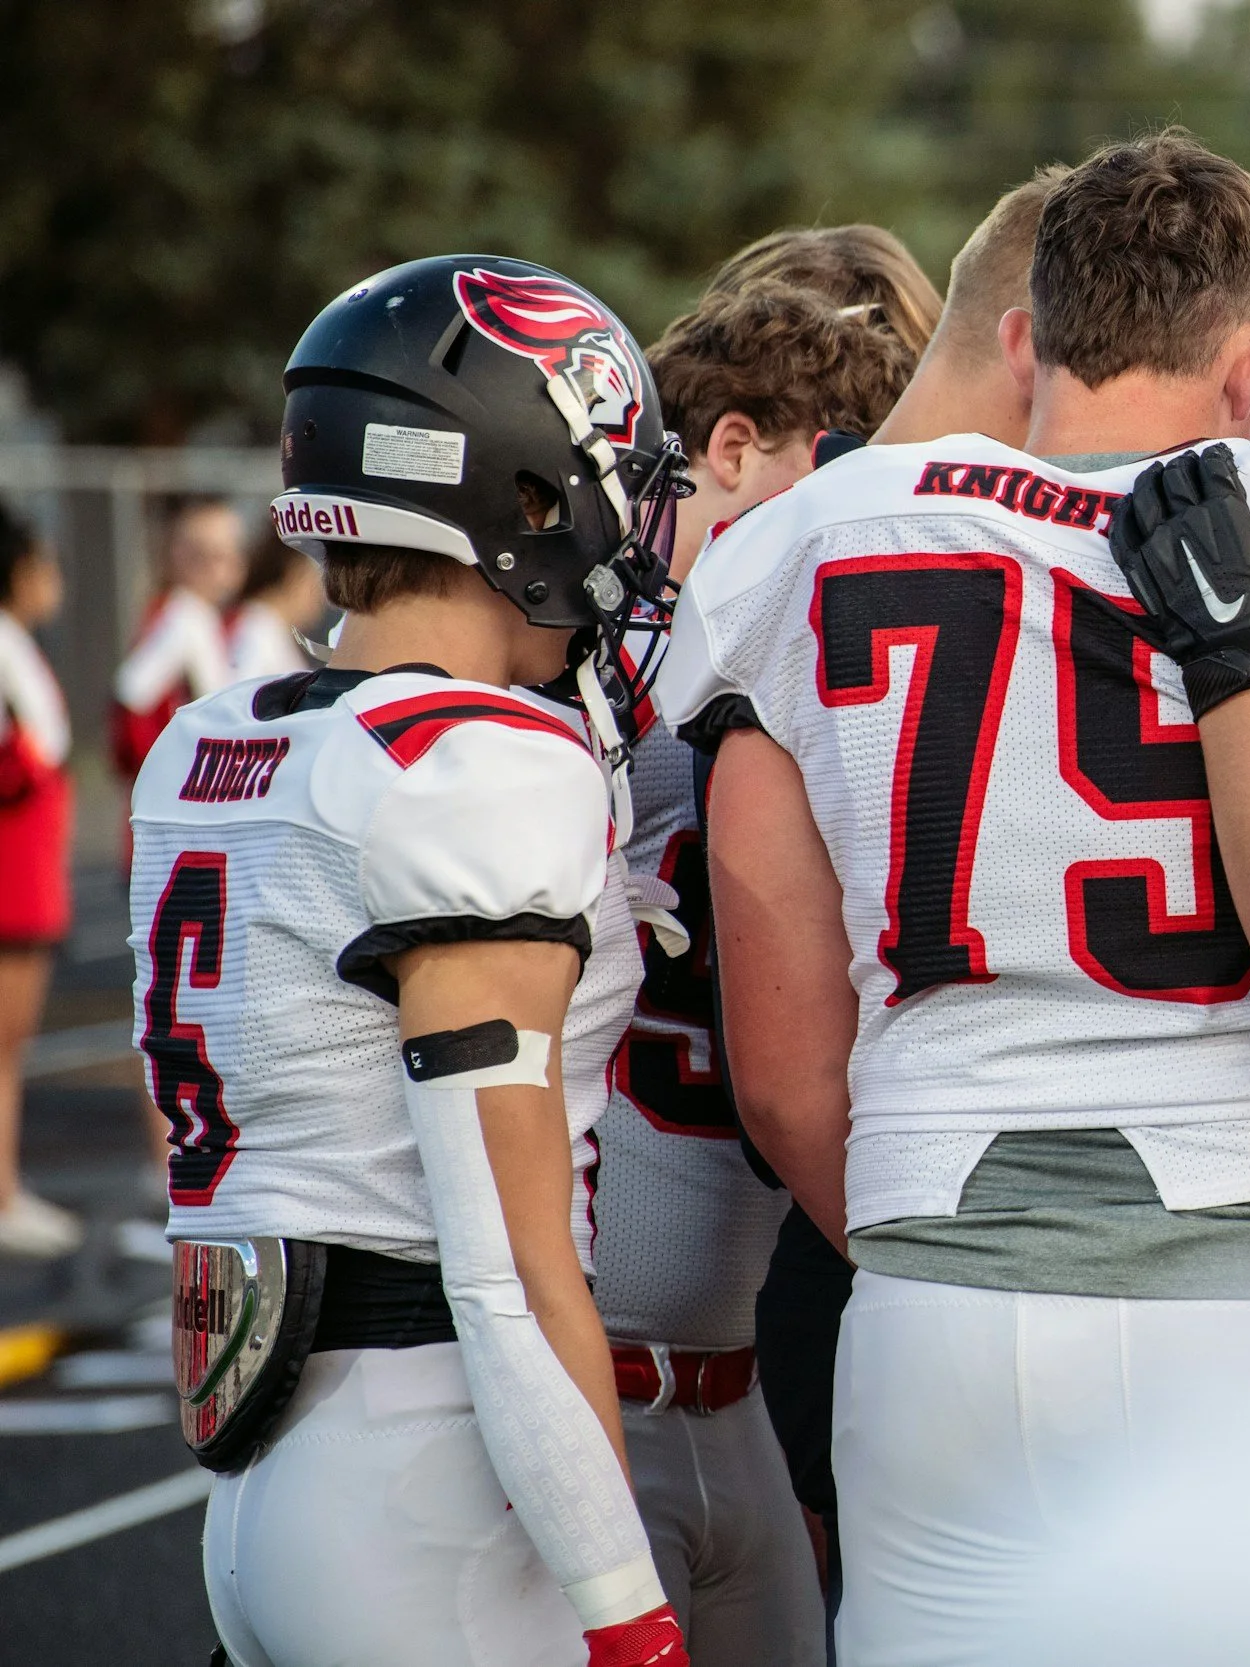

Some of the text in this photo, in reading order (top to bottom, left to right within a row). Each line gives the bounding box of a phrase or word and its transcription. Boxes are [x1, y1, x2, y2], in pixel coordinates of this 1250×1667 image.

[396, 429, 430, 439] WARNING
[914, 461, 1126, 539] KNIGH
[179, 737, 290, 803] KNIGHTS
[140, 851, 240, 1207] 6
[410, 1051, 423, 1069] KT
